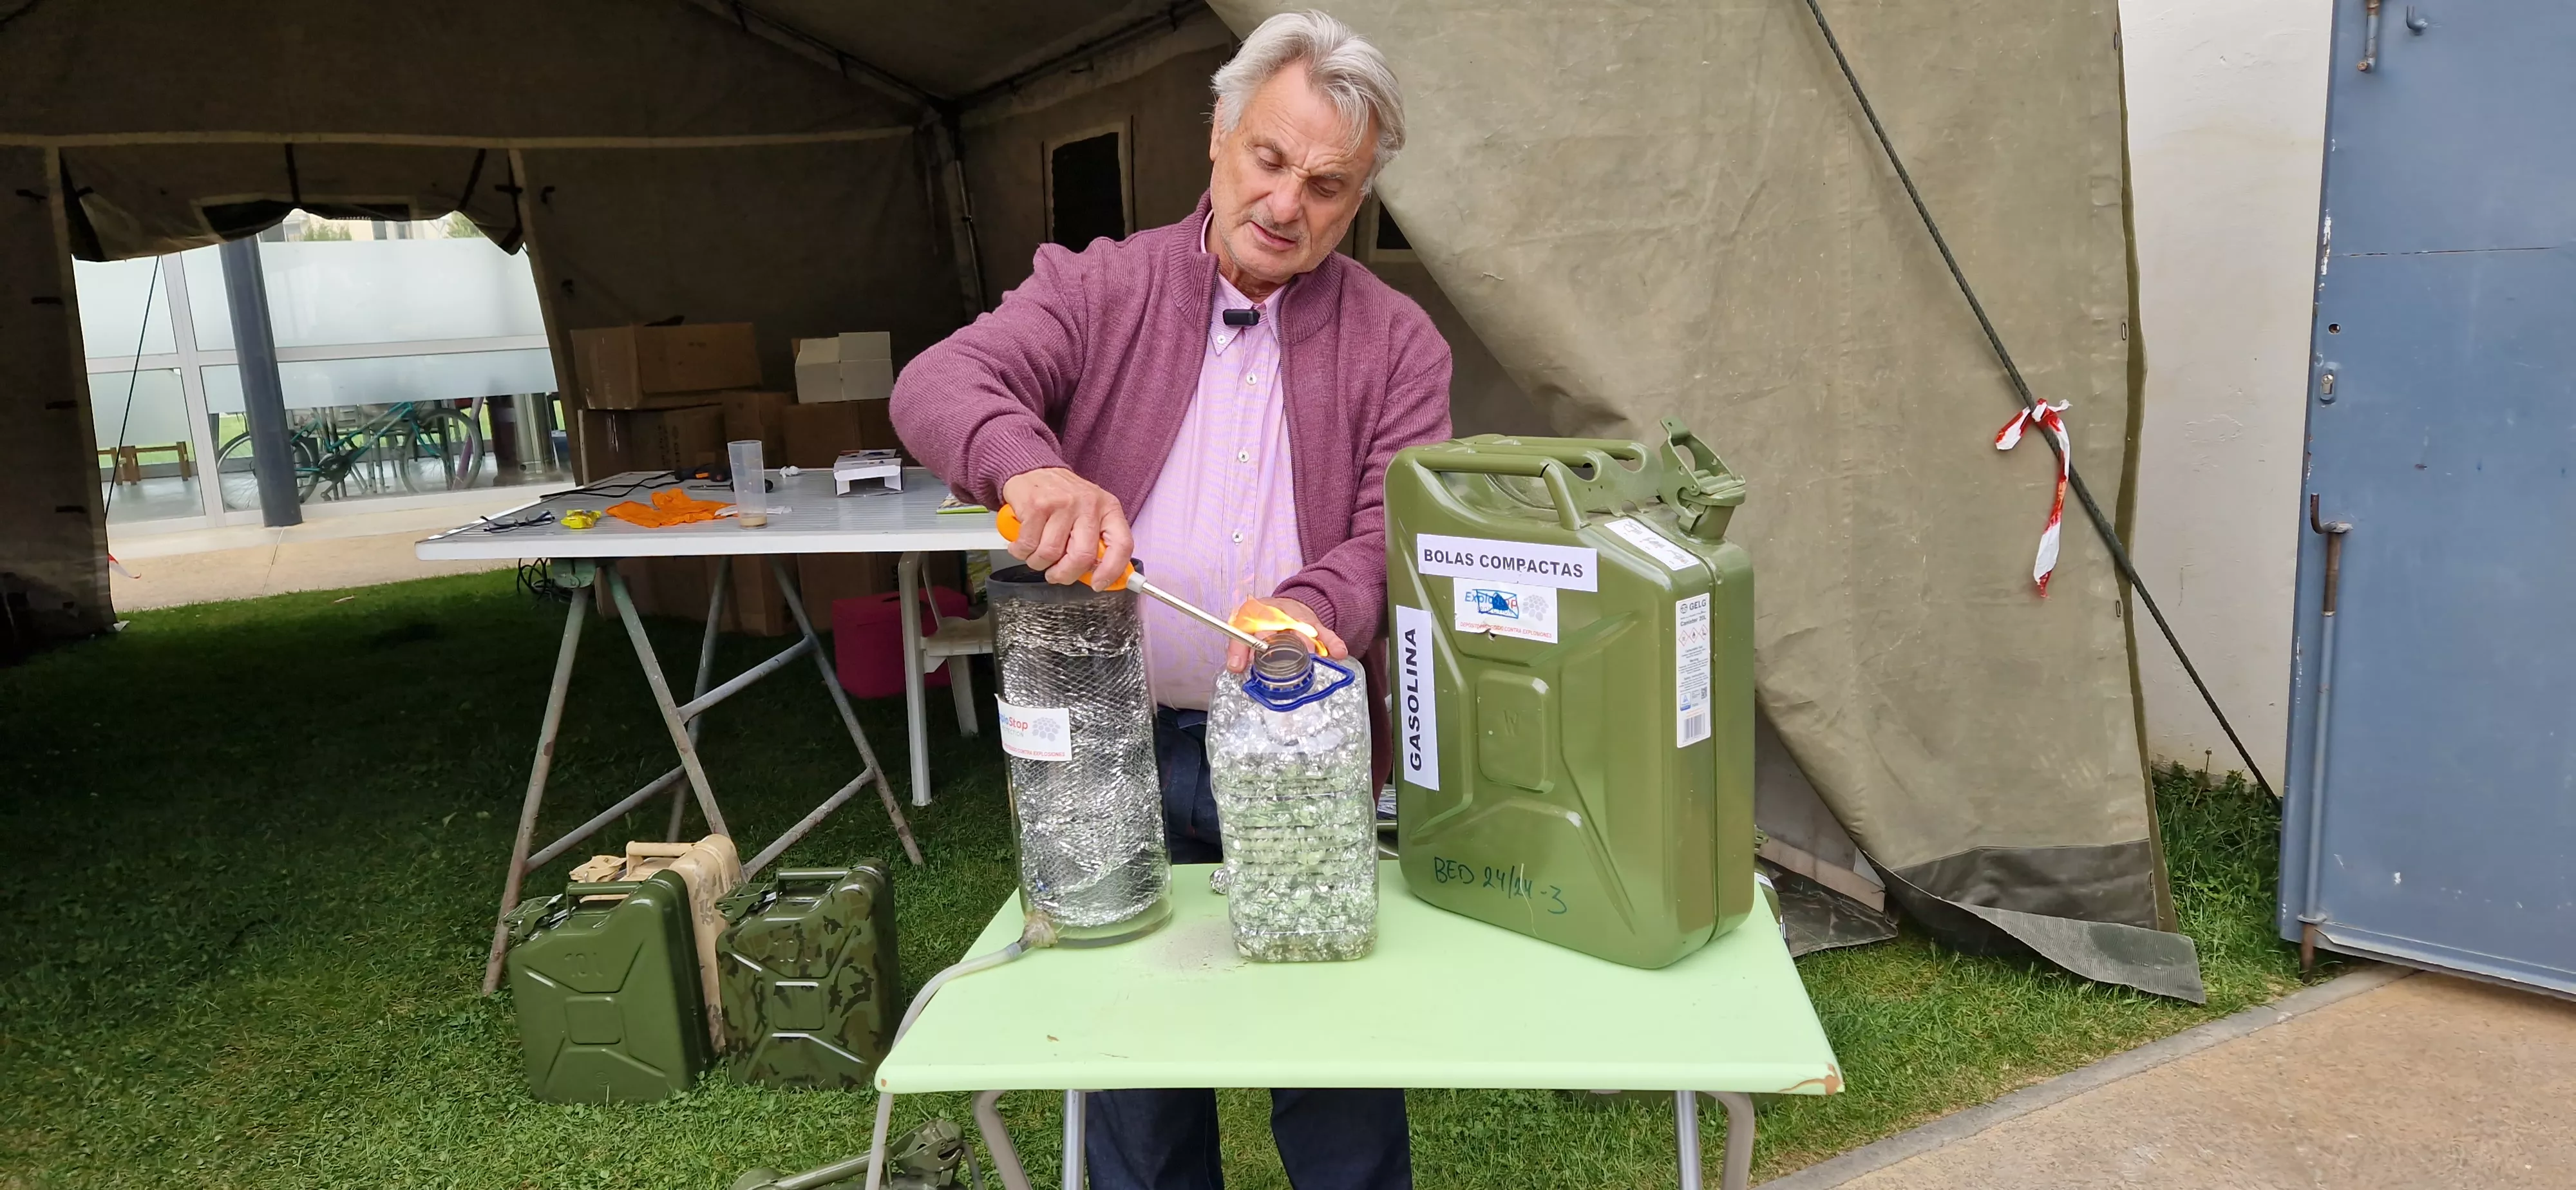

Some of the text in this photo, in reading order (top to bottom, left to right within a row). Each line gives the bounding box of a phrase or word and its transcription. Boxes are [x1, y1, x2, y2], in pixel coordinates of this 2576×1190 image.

[1424, 549, 1584, 578] BOLAS COMPACTAS
[1689, 599, 1707, 610] GELG
[1405, 628, 1423, 771] GASOLINA
[1434, 856, 1475, 884] BED
